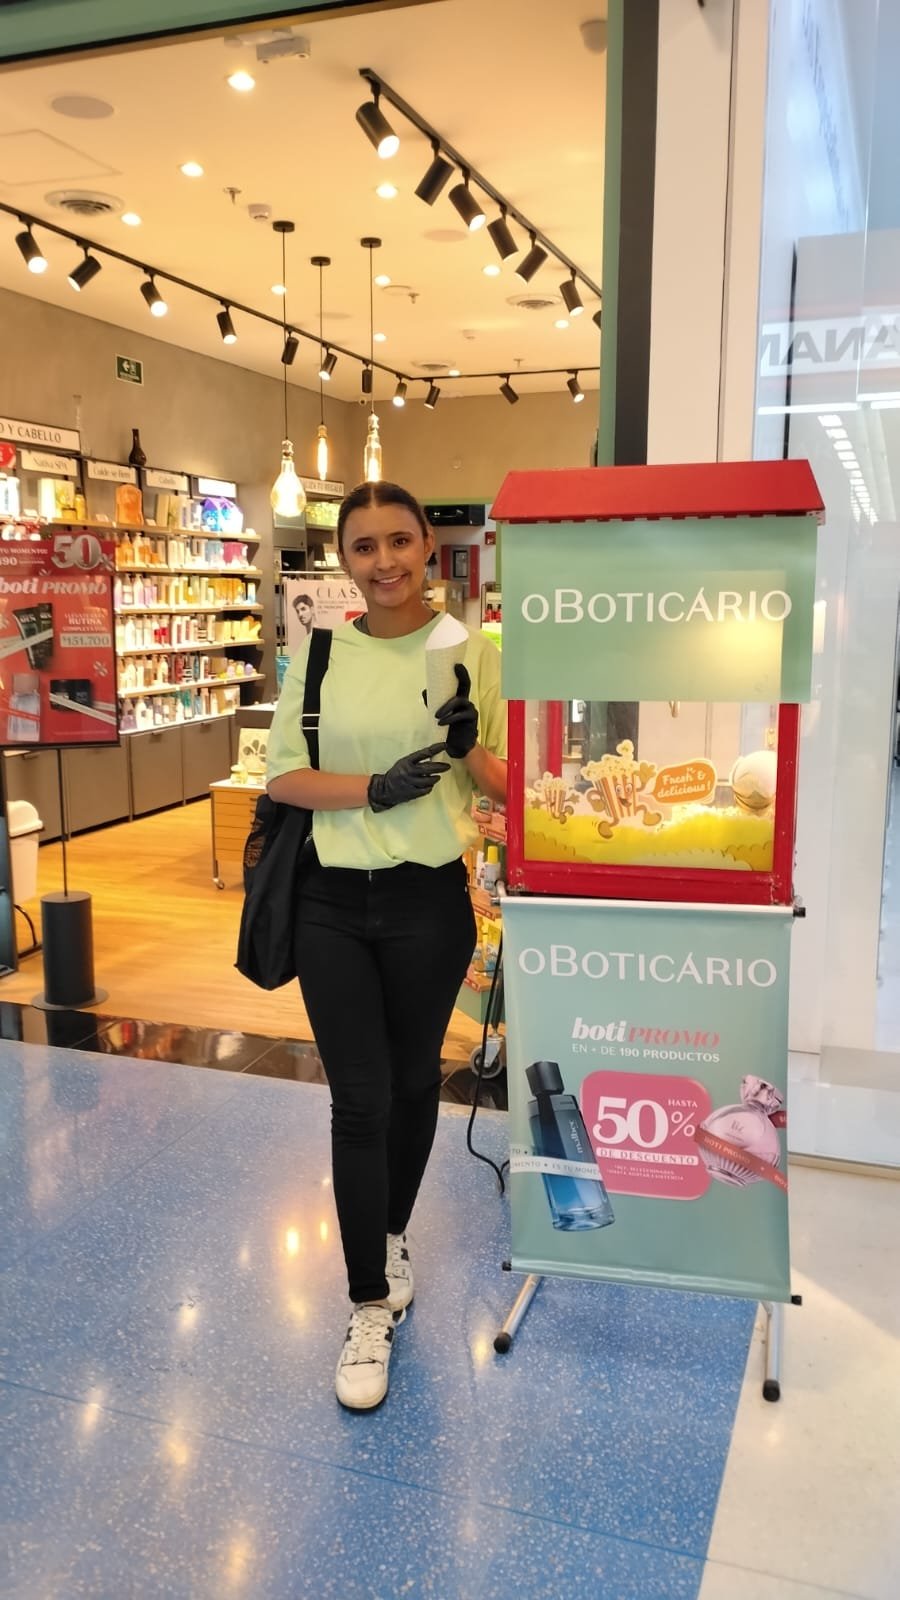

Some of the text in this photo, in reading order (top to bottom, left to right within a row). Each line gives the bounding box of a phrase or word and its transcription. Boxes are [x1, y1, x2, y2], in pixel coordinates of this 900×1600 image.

[8, 424, 14, 435] Y
[18, 427, 62, 443] CABELLO
[0, 578, 107, 595] boti PROMO
[662, 768, 693, 786] Fresh
[572, 1043, 587, 1053] EN
[601, 1046, 616, 1056] DE
[620, 1047, 640, 1058] 190
[643, 1050, 720, 1063] PRODUCTOS
[668, 1099, 698, 1108] HASTA
[600, 1148, 695, 1165] DE DESCUENTO
